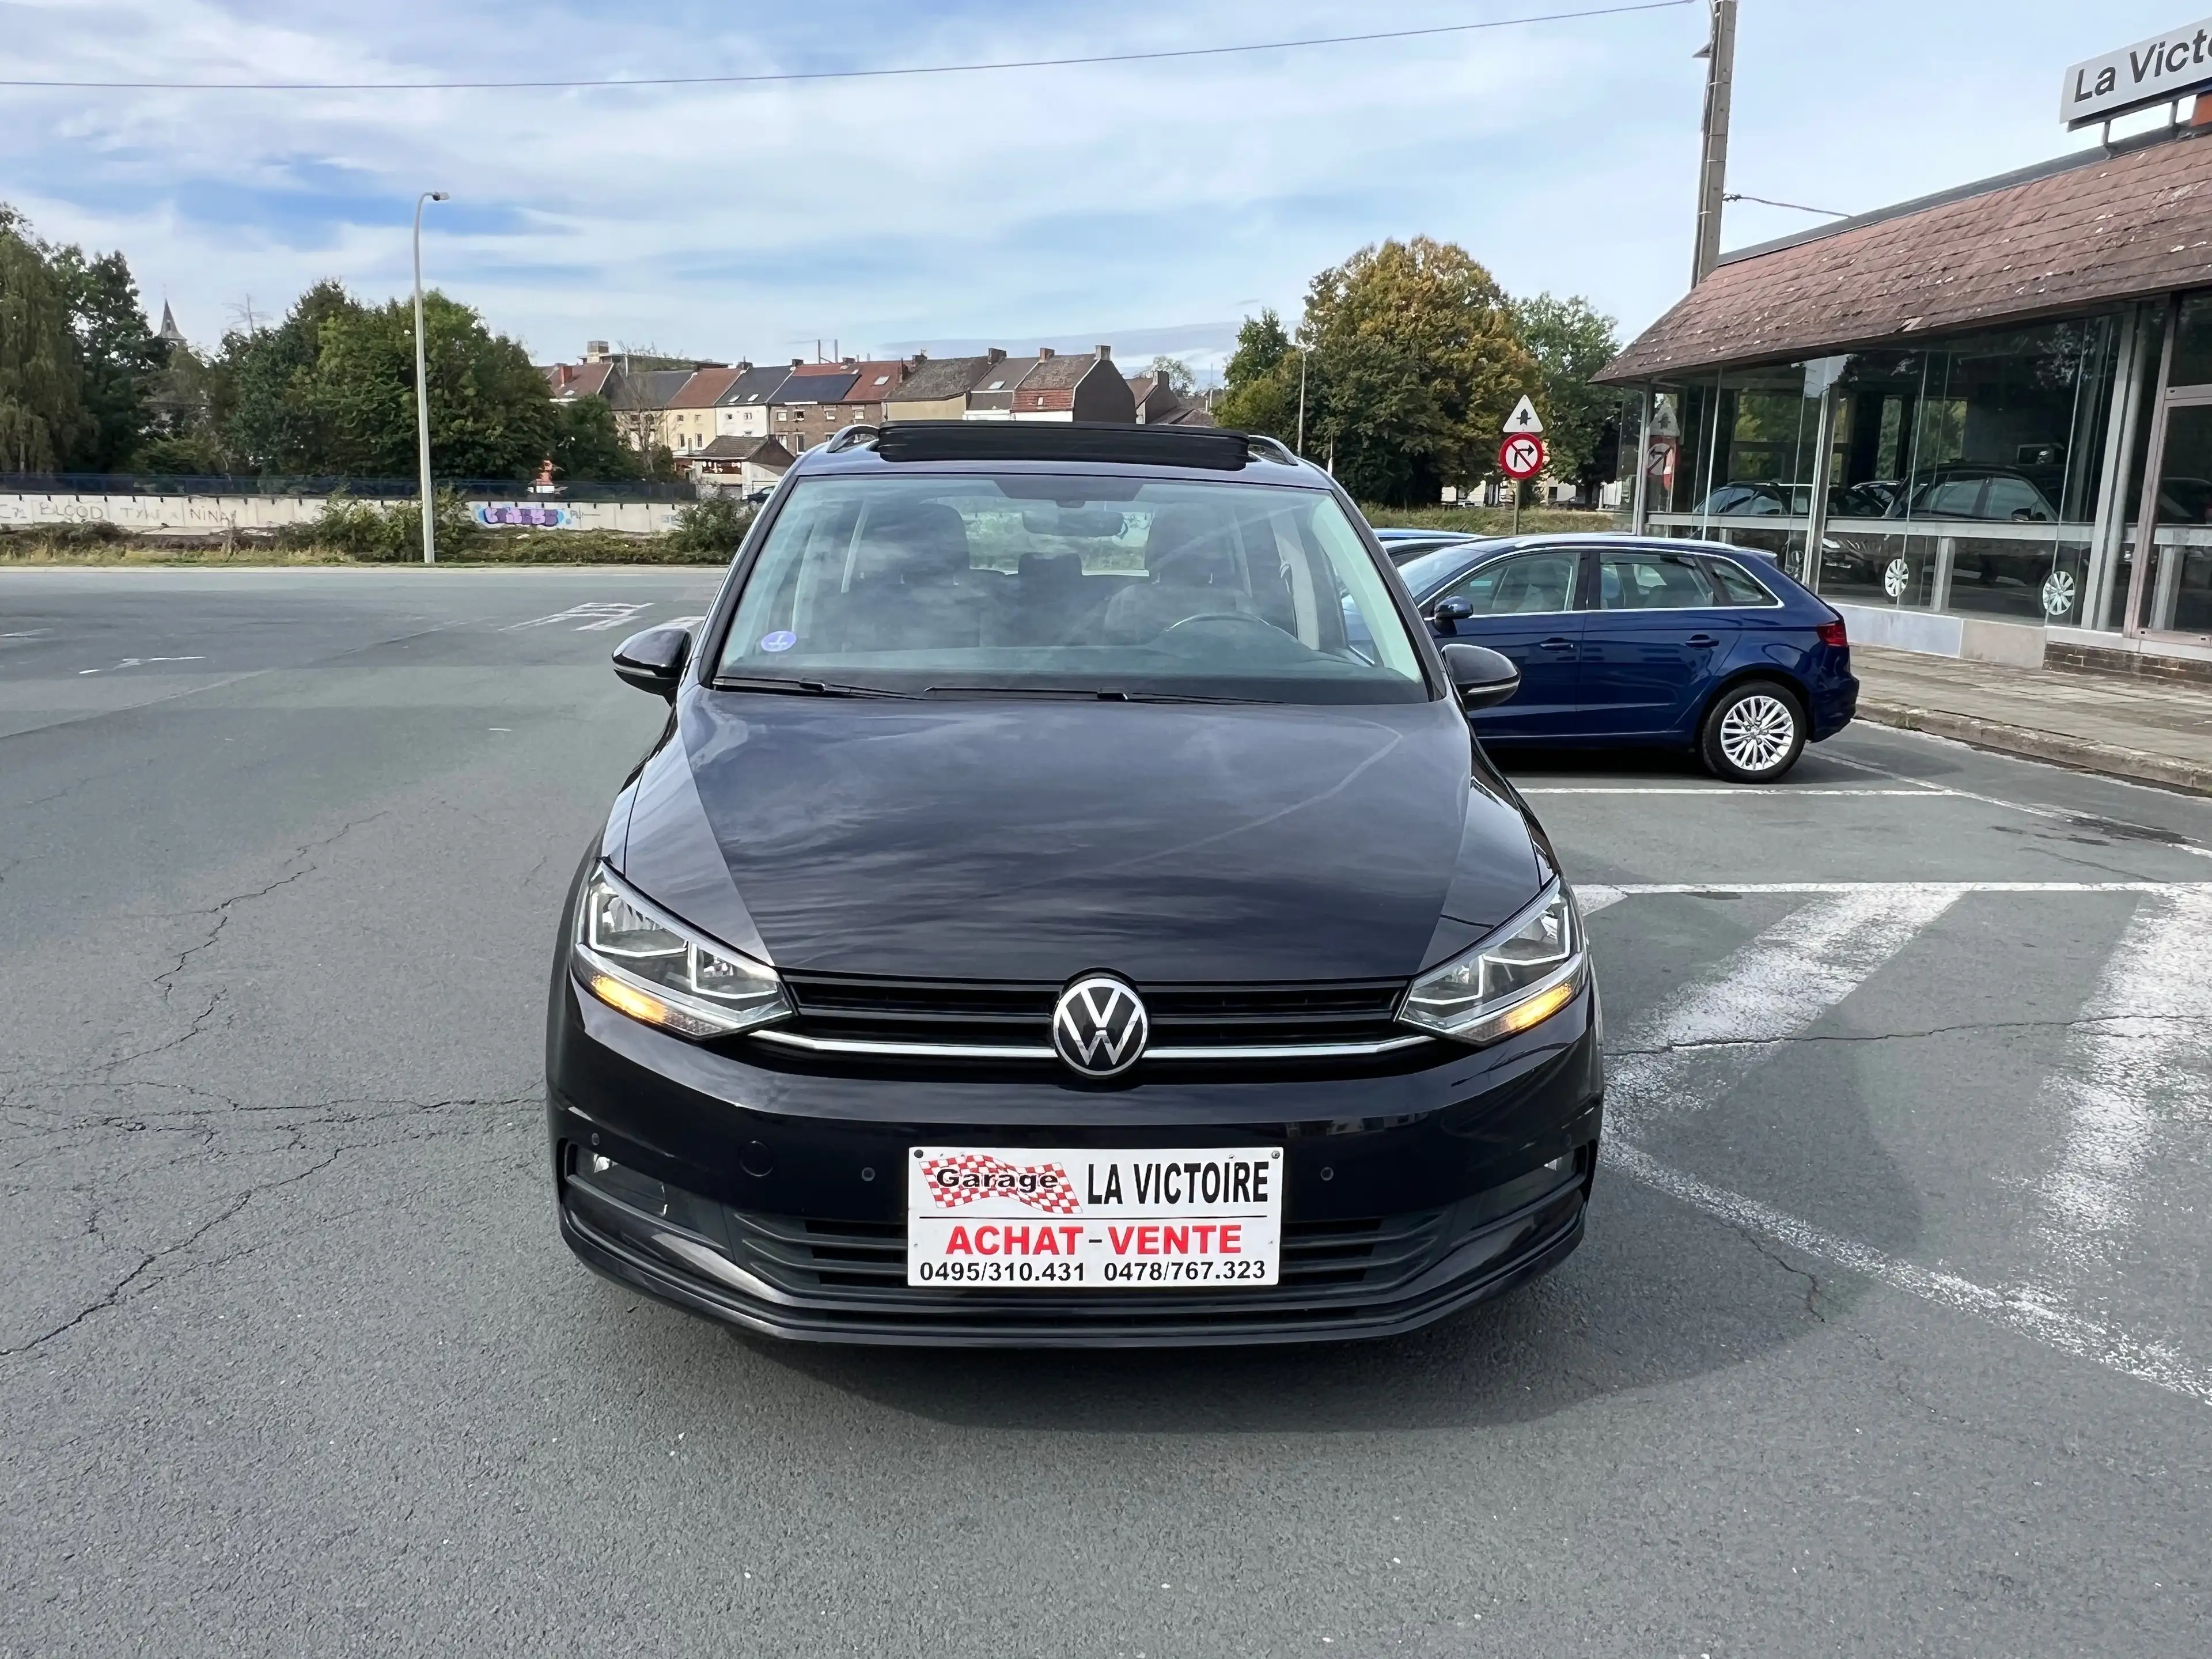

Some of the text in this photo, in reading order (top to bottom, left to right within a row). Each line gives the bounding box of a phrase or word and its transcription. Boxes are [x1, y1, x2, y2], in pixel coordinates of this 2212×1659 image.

[2074, 29, 2212, 103] La Vict
[937, 1161, 1269, 1205] Garage LA VICTOIRE
[920, 1260, 1265, 1281] 0495/310.431 0478/767.323
